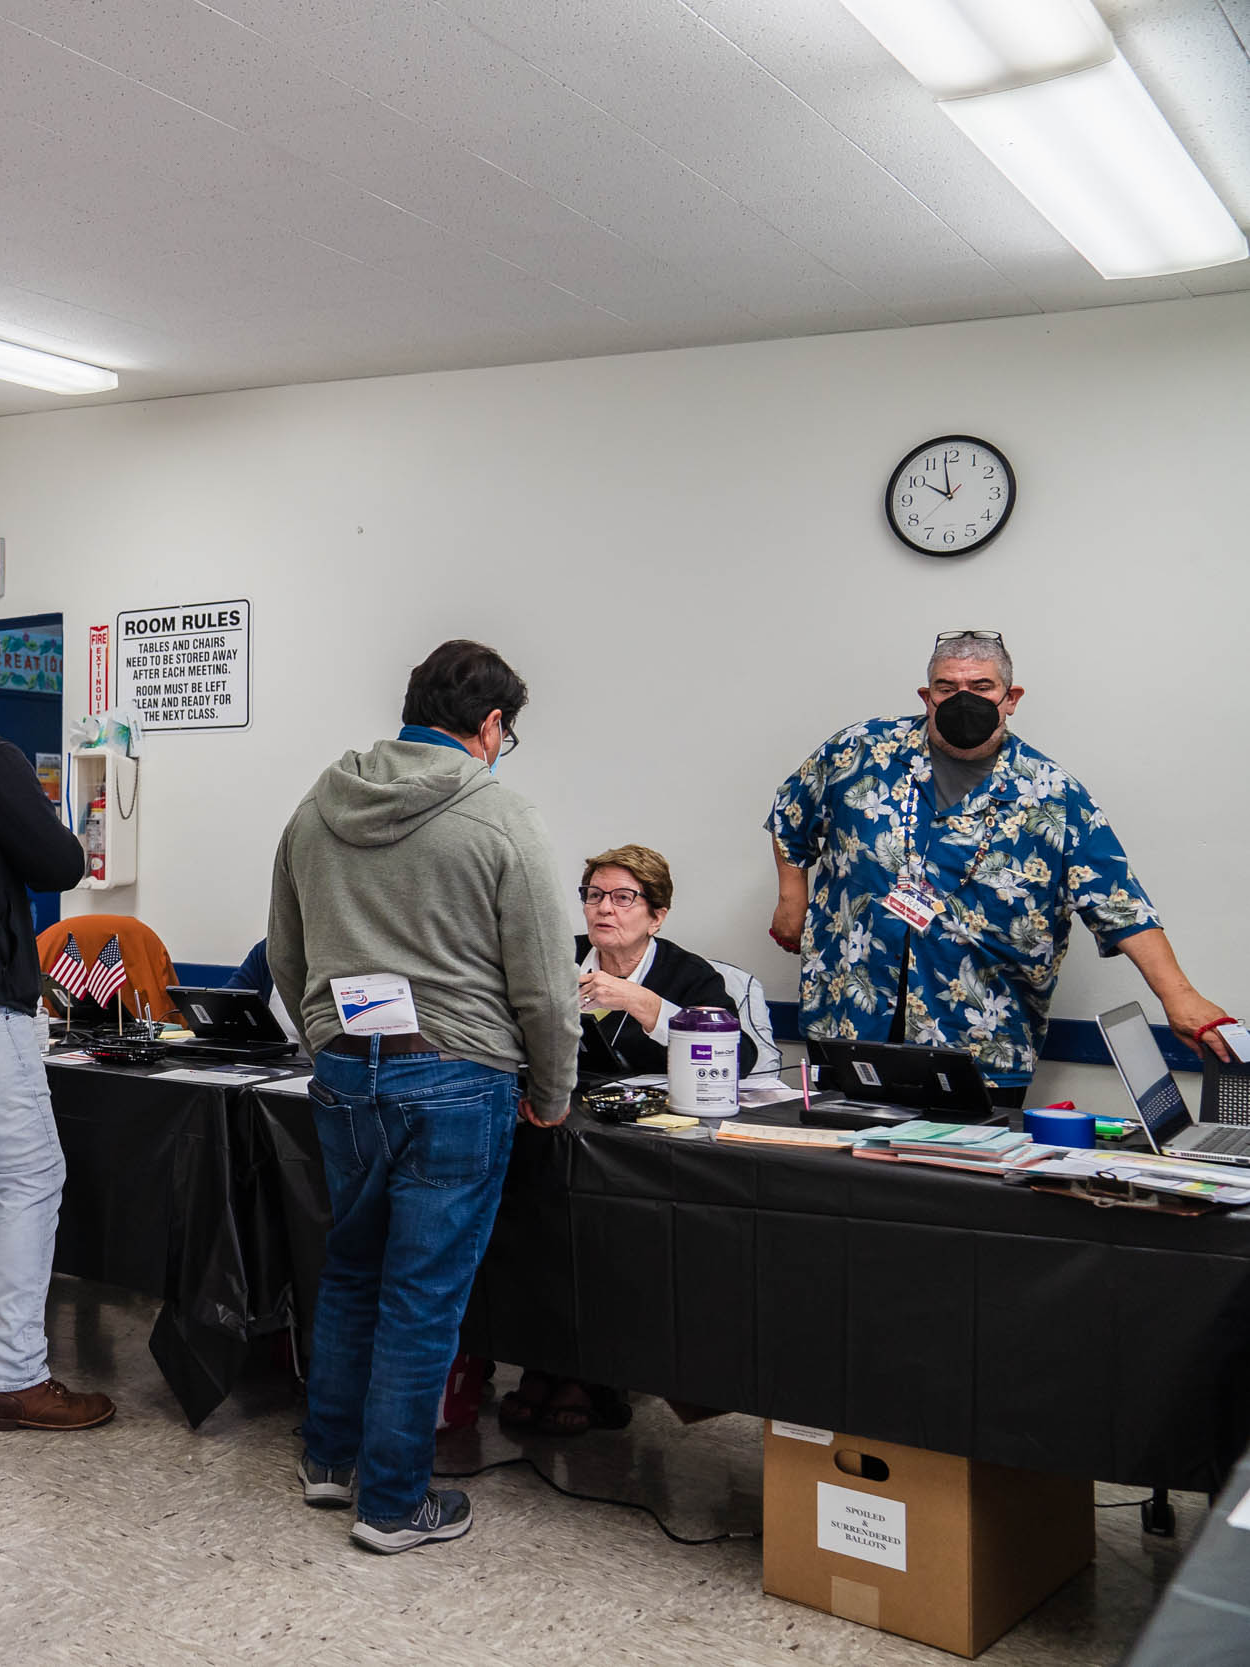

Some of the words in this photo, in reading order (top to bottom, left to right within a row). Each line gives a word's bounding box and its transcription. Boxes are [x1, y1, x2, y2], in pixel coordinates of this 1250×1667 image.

[944, 450, 960, 463] 12
[971, 454, 977, 467] 1
[925, 458, 937, 471] 11
[983, 466, 994, 479] 2
[909, 475, 926, 488] 10
[901, 494, 913, 507] 9
[989, 487, 1001, 500] 3
[907, 513, 919, 526] 8
[980, 508, 993, 521] 4
[923, 527, 935, 540] 7
[943, 530, 955, 544] 6
[964, 523, 977, 537] 5
[125, 616, 175, 636] ROOM
[182, 610, 241, 630] RULES
[91, 633, 107, 645] FIRE
[139, 641, 170, 654] TABLES
[172, 639, 190, 651] AND
[193, 636, 225, 649] CHAIRS
[126, 656, 148, 668] NEED
[150, 655, 161, 666] TO
[163, 654, 174, 665] BE
[176, 651, 210, 664] STORED
[213, 649, 238, 661] AWAY
[133, 668, 160, 680] AFTER
[162, 666, 185, 678] EACH
[188, 663, 231, 677] MEETING.
[136, 684, 161, 696] ROOM
[164, 682, 189, 695] MUST
[191, 682, 203, 693] BE
[205, 680, 227, 692] LEFT
[161, 696, 179, 708] AND
[181, 694, 211, 707] READY
[214, 693, 231, 705] FOR
[144, 710, 160, 722] THE
[162, 709, 185, 721] NEXT
[187, 707, 218, 720] CLASS.
[845, 1506, 886, 1522] SPOILED
[831, 1520, 901, 1545] SURRENDERED
[845, 1533, 887, 1550] BALLOTS
